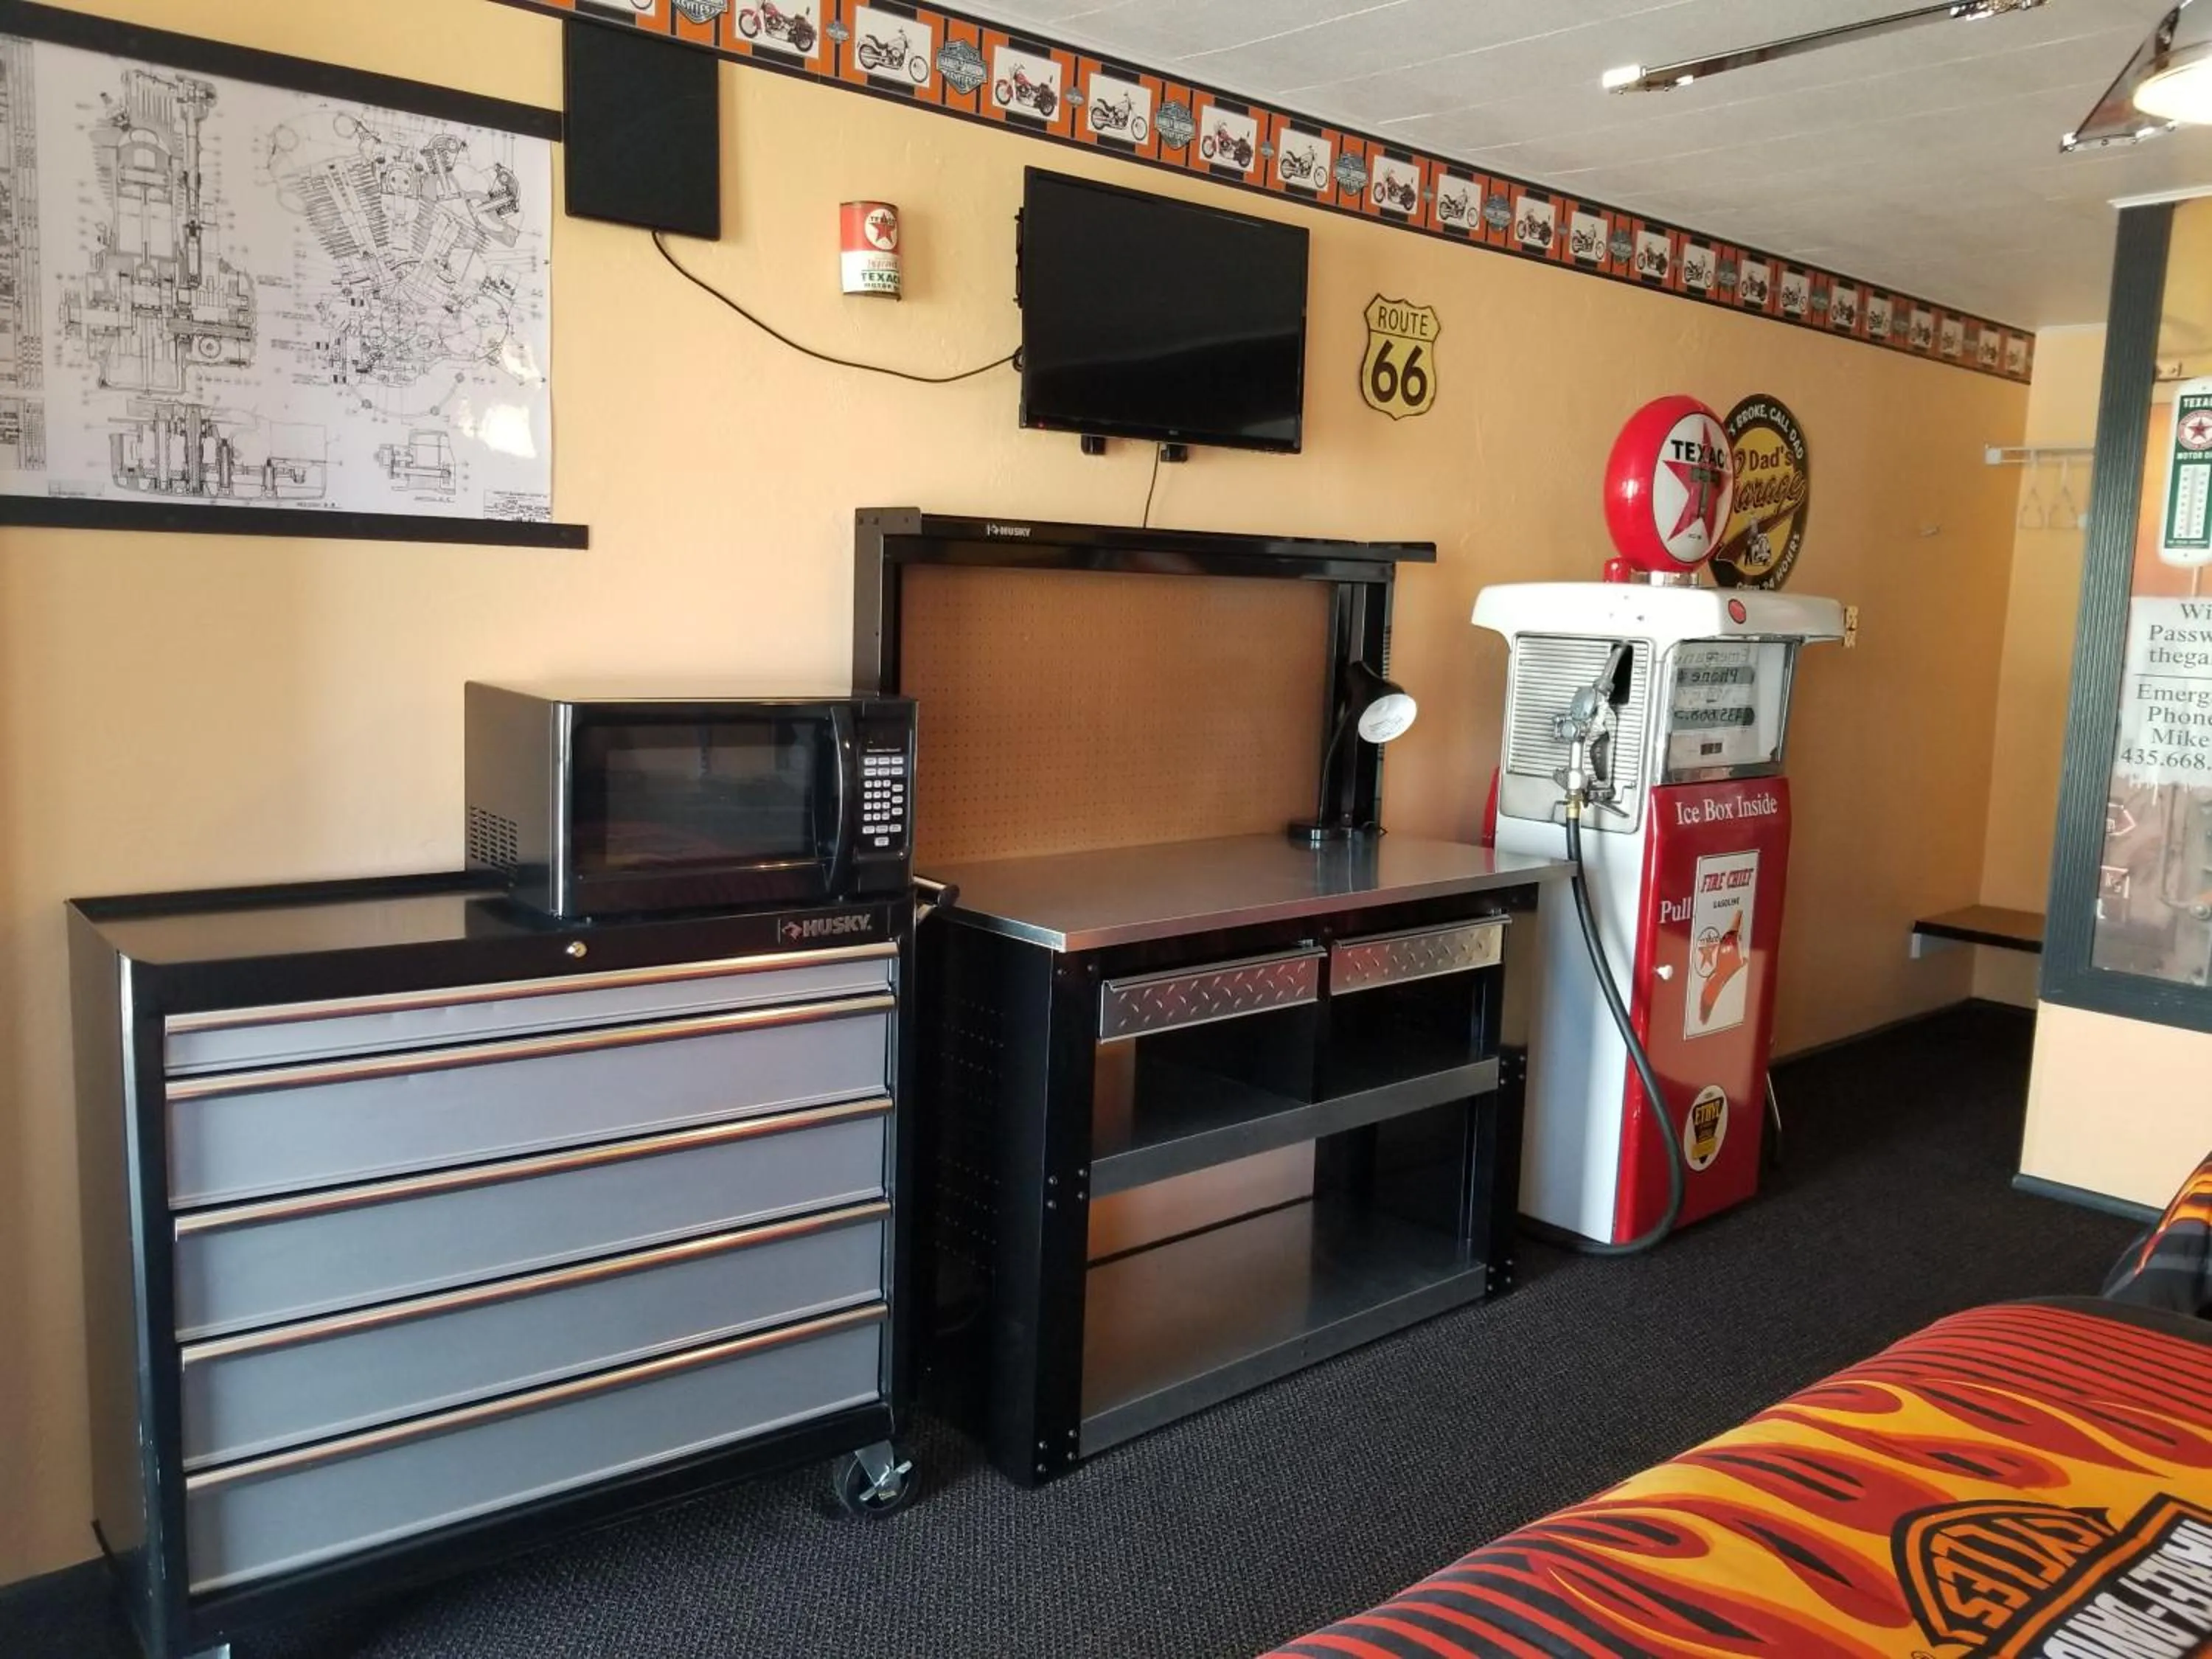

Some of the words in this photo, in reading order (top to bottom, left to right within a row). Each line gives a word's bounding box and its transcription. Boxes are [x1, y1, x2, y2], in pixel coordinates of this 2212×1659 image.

[1378, 306, 1428, 336] ROUTE
[1371, 339, 1427, 406] 66
[1770, 407, 1790, 433] CALL
[1790, 429, 1804, 459] DAD
[1749, 445, 1792, 470] Dad's
[1000, 526, 1031, 538] HUSKY
[2149, 625, 2212, 643] Passw
[2136, 684, 2211, 708] Emerg
[2152, 728, 2210, 748] Mike
[2121, 748, 2211, 771] 435.668.
[1675, 801, 1700, 825] Ice
[1703, 799, 1734, 821] Box
[1736, 793, 1778, 818] Inside
[1660, 896, 1692, 924] Pull
[803, 914, 871, 937] HUSKY
[1931, 1517, 2104, 1629] CYCLES
